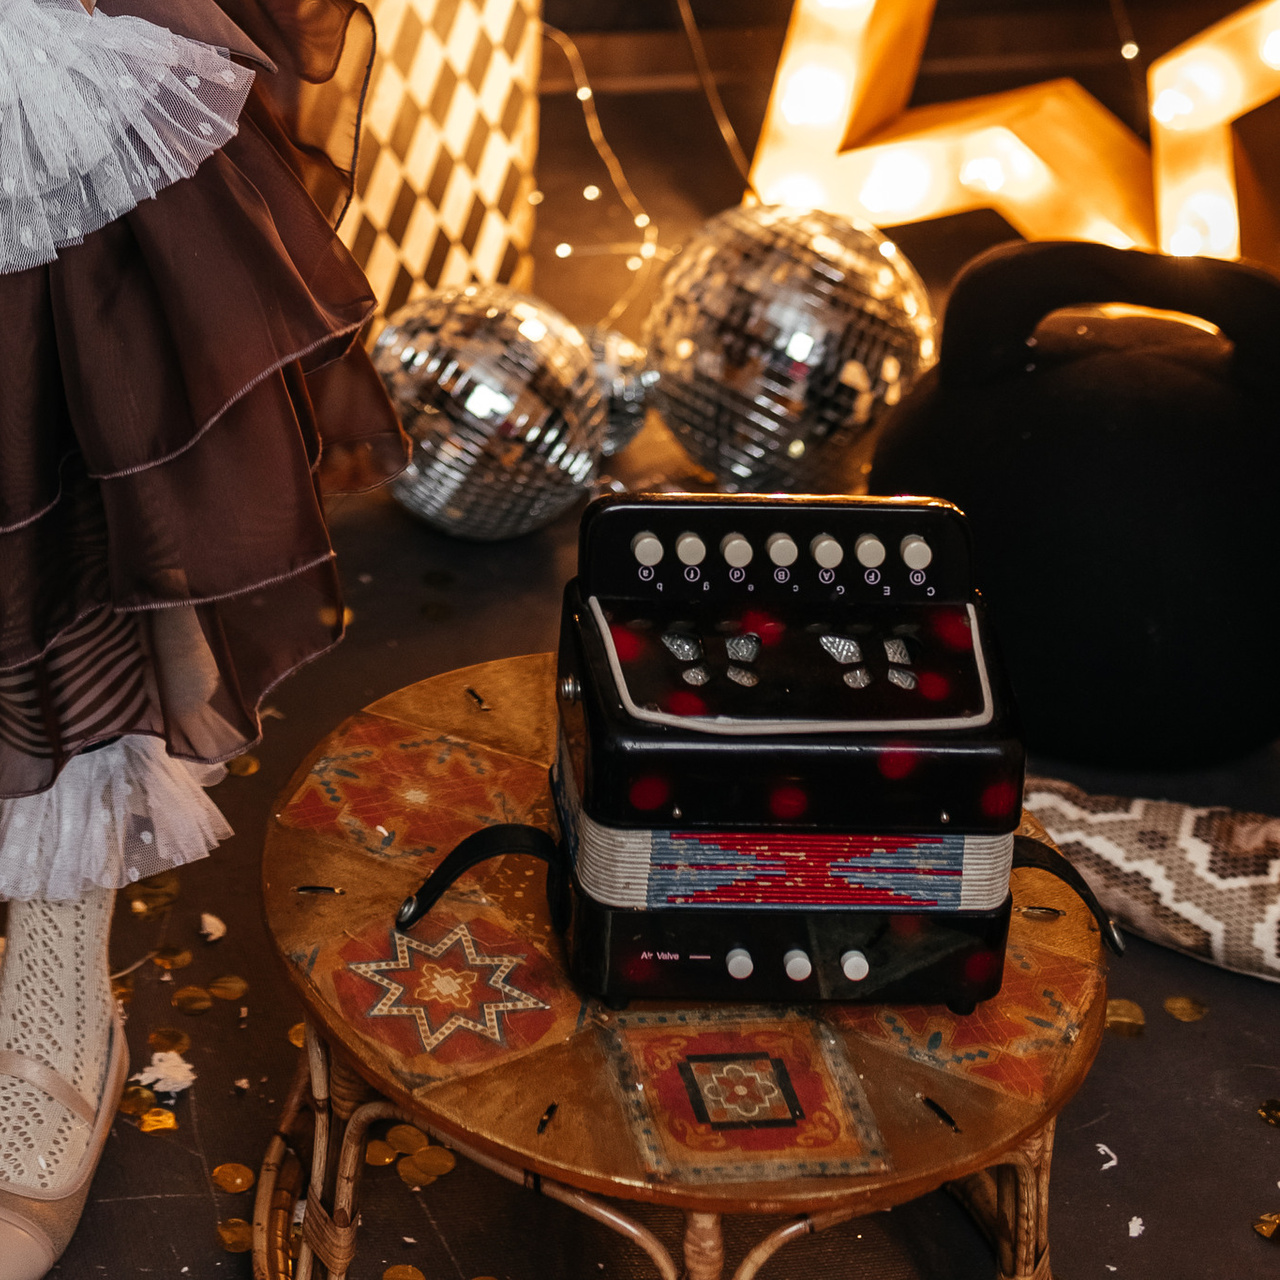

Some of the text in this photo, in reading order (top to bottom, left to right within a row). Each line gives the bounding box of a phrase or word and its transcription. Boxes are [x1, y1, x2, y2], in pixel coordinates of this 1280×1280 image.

[836, 585, 845, 595] G
[883, 586, 891, 596] E
[926, 586, 936, 596] C
[640, 951, 680, 960] Air Valve
